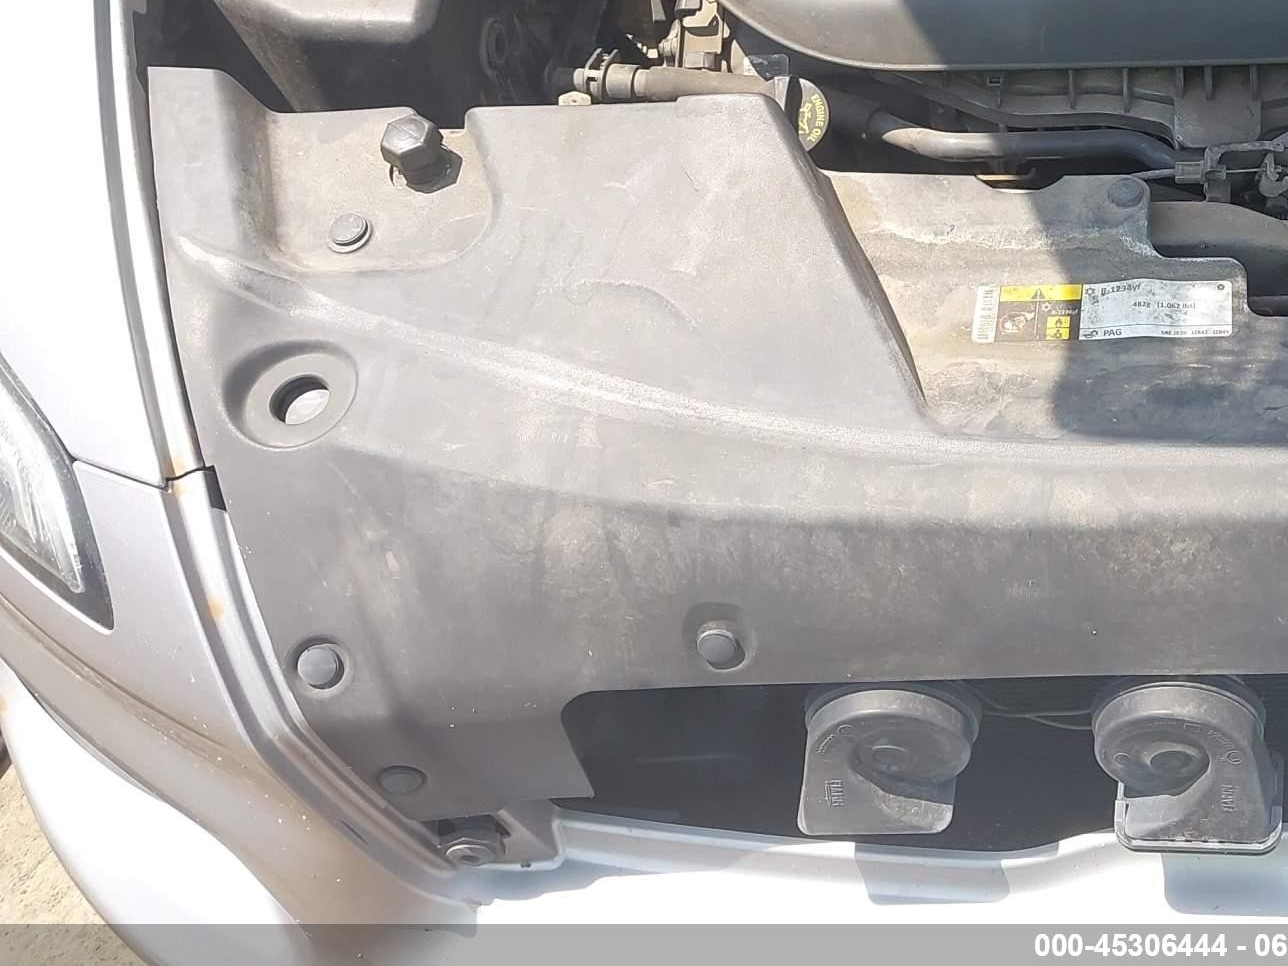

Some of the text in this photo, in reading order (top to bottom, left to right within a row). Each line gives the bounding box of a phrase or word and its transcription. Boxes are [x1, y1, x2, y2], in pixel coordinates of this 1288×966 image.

[806, 94, 825, 142] ENGINE OIL
[1103, 328, 1122, 336] PAG
